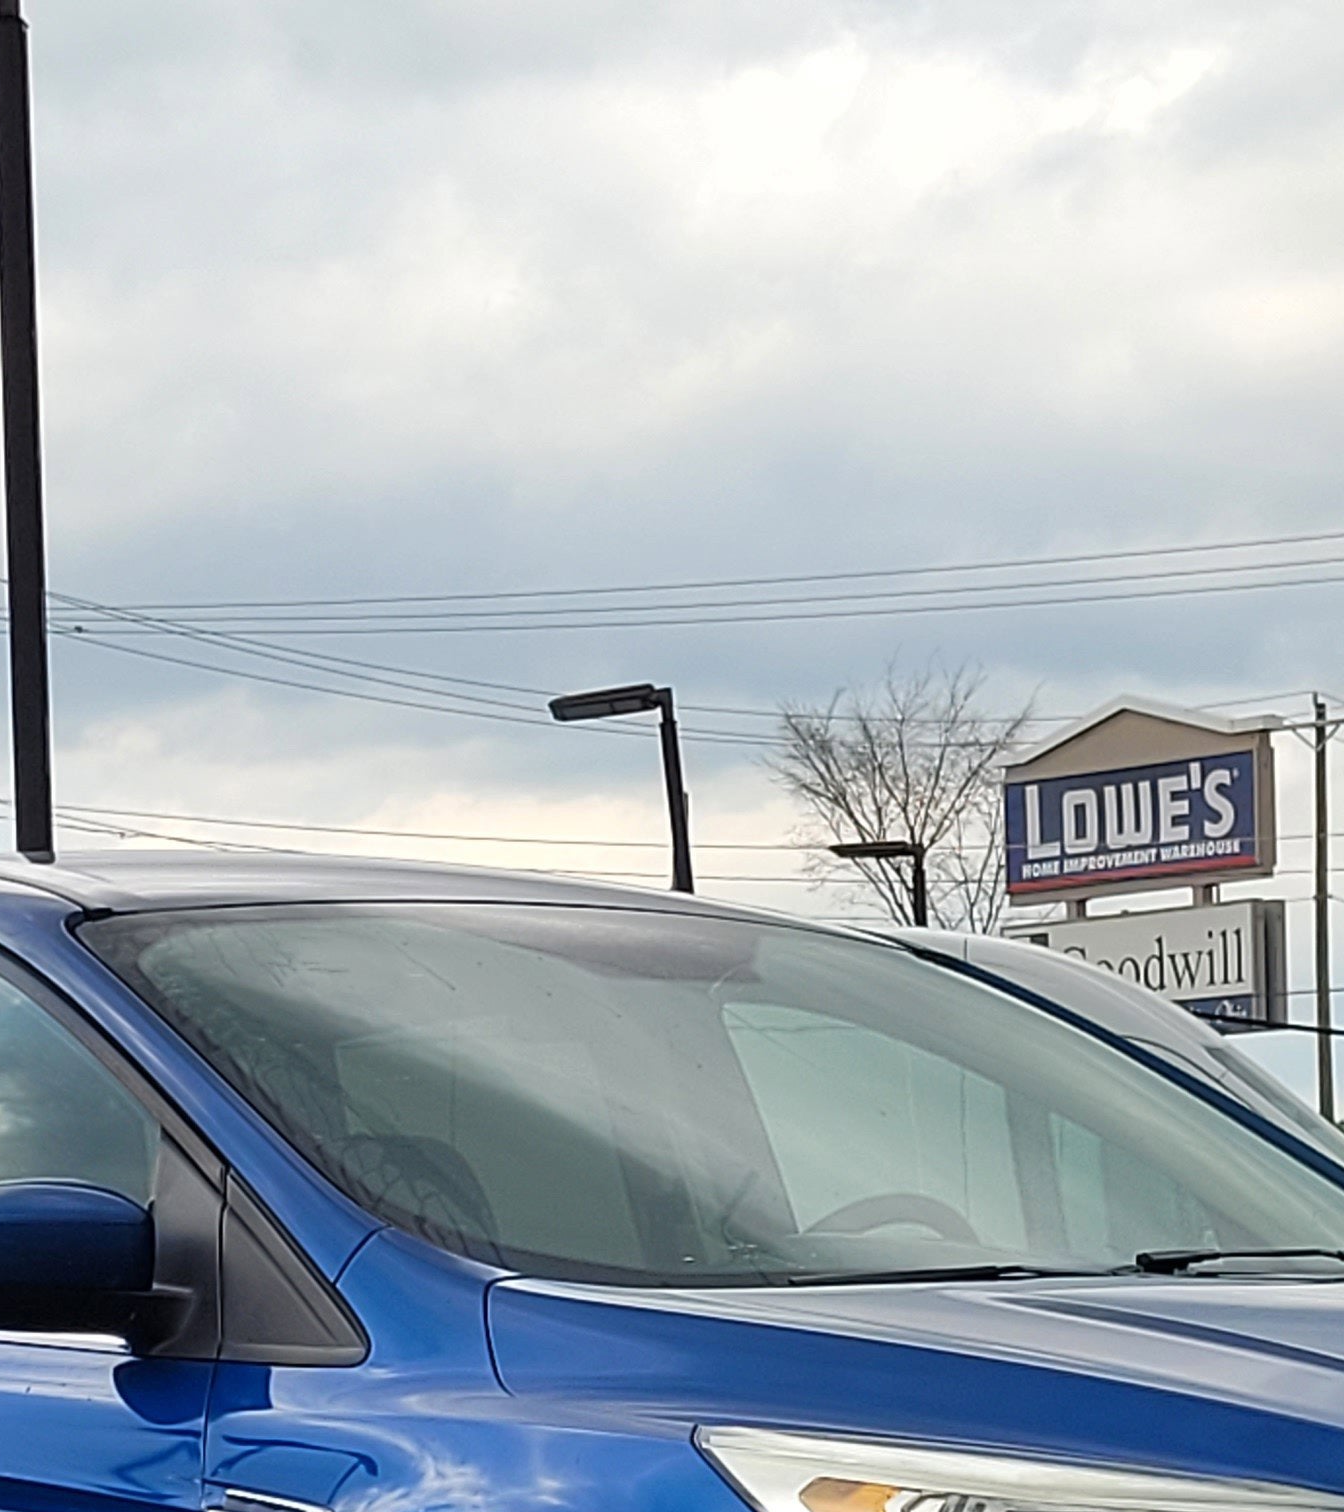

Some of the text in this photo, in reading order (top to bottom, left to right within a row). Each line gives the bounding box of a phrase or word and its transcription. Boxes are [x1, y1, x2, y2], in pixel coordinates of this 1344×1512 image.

[1024, 762, 1235, 860] LOWE'S
[1022, 839, 1240, 879] HOME IMPROVEMENT WAREHOUSE
[1063, 928, 1246, 992] odwill
